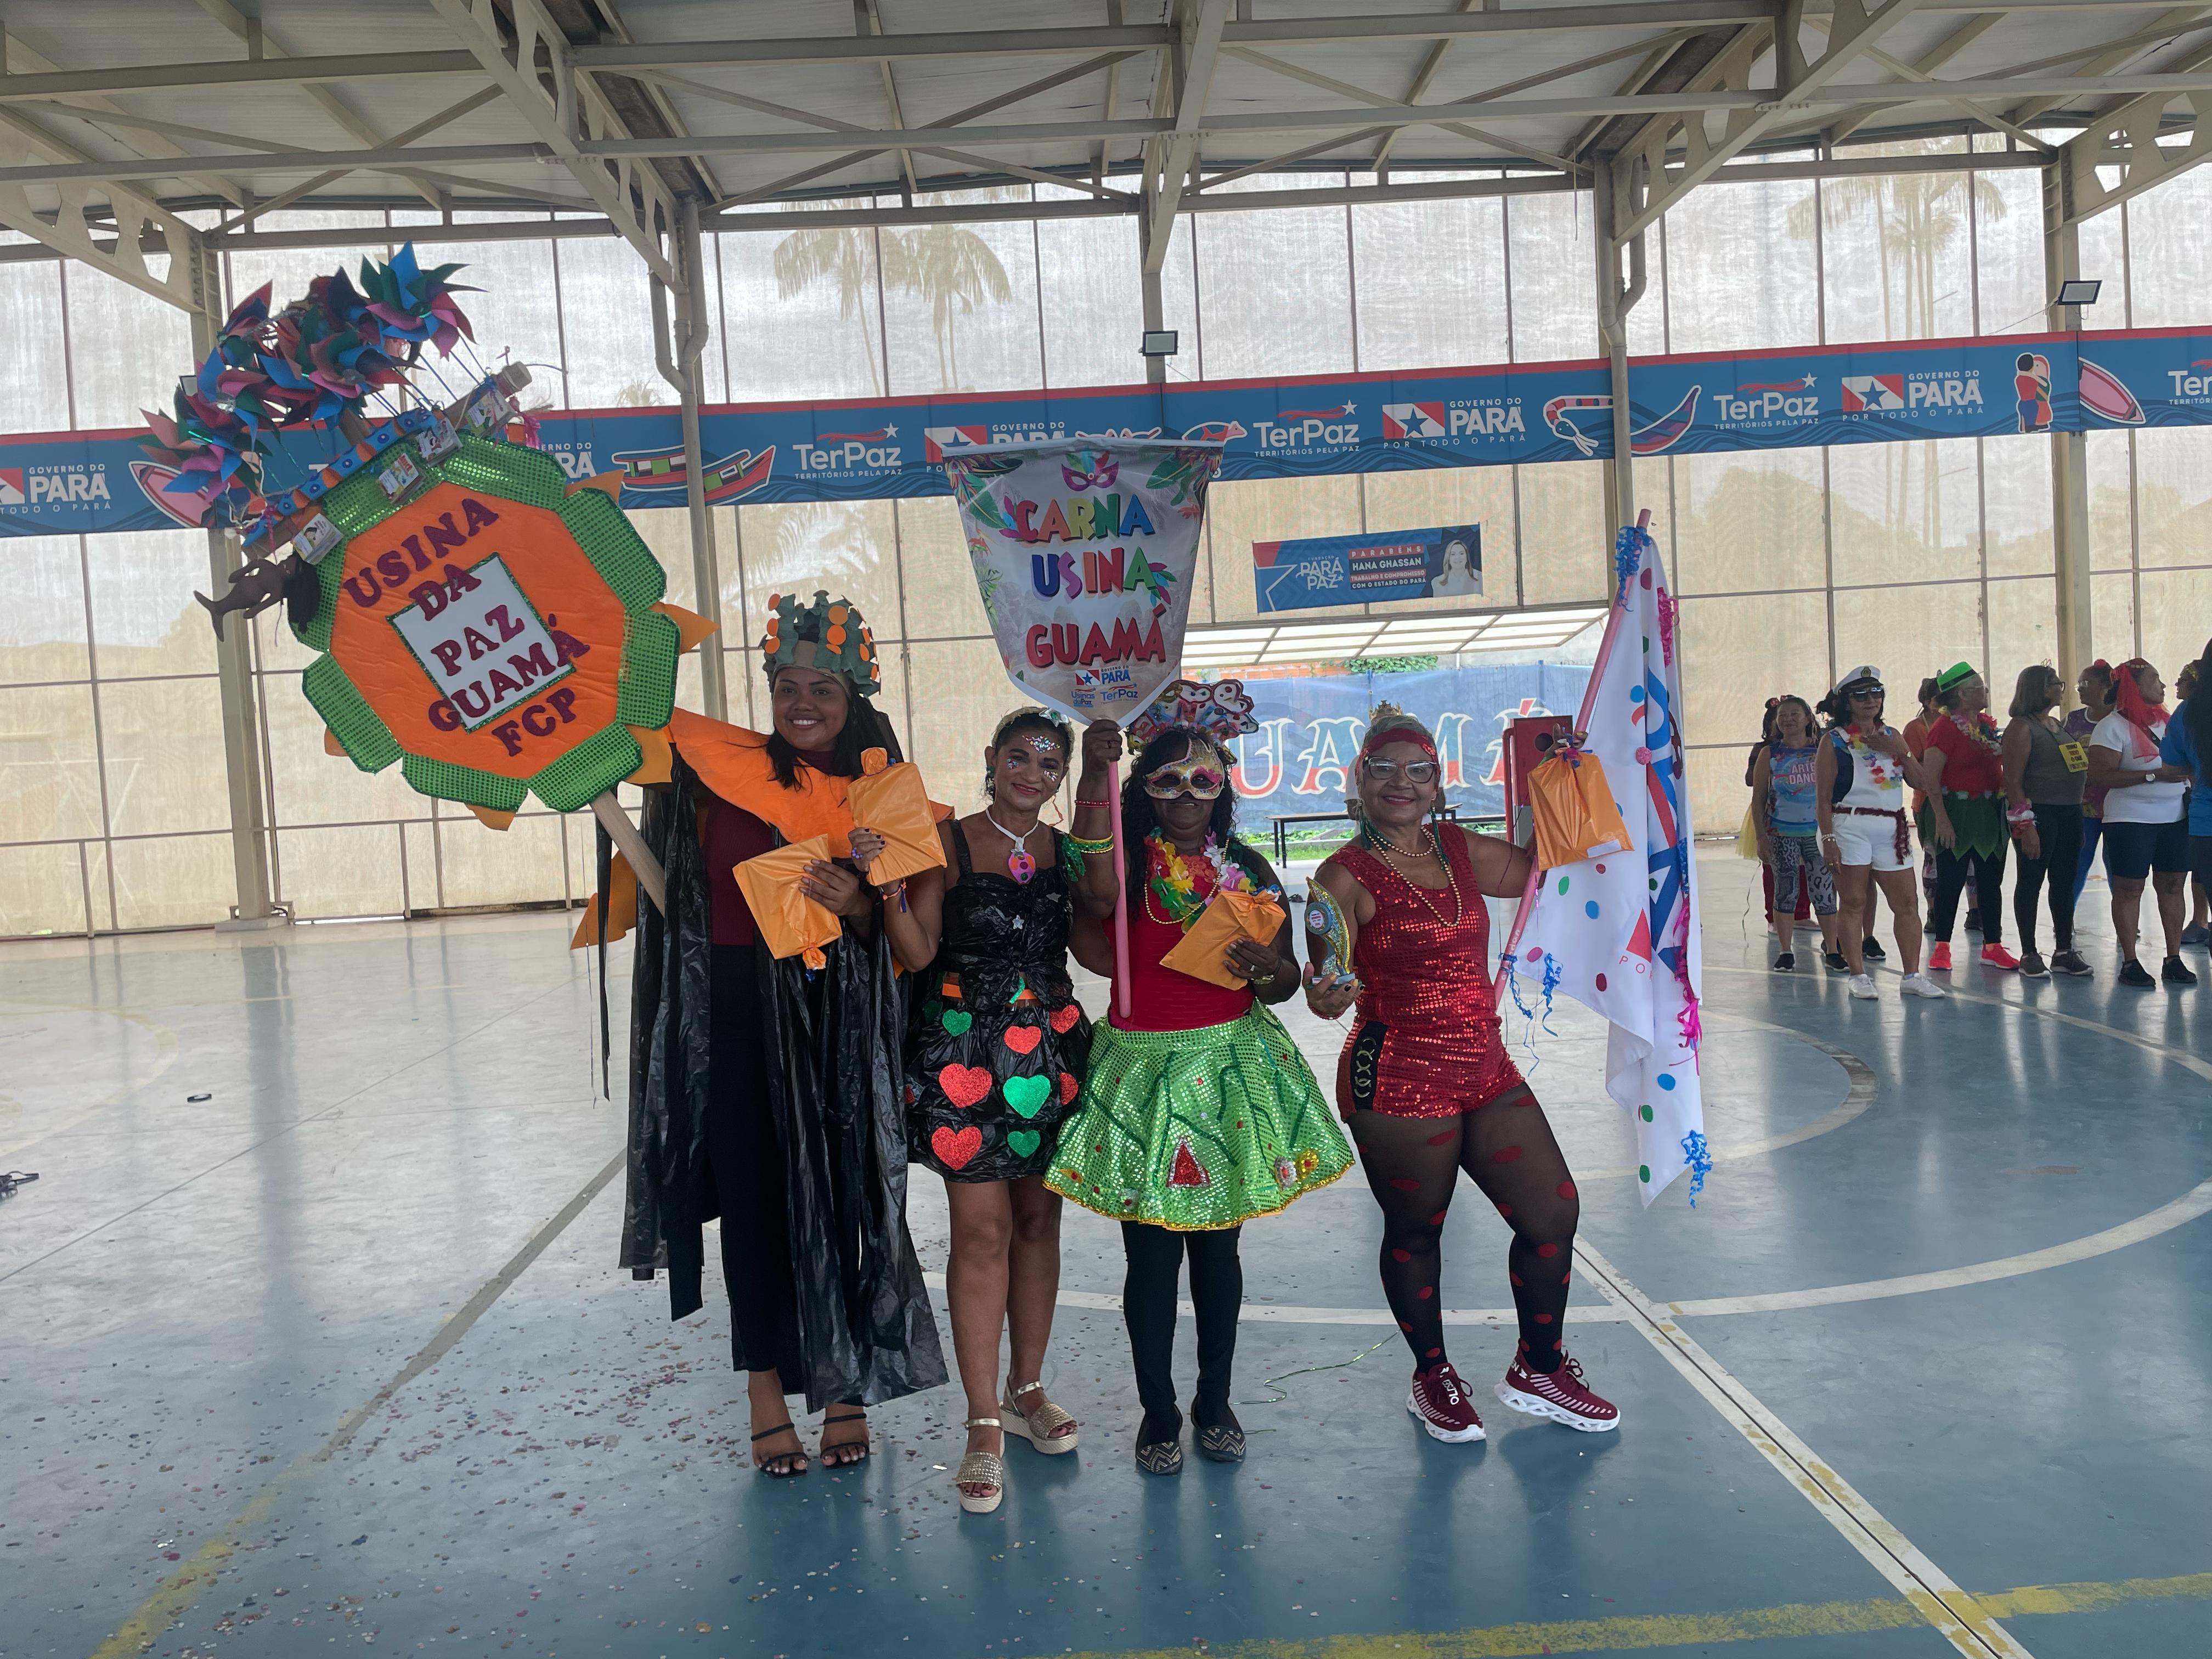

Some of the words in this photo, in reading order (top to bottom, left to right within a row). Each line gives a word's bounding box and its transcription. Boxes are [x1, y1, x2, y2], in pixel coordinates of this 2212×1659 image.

[1909, 371, 1960, 380] GOVERNO
[1909, 379, 1984, 409] PARÁ
[2169, 397, 2212, 405] TERRITÓR
[1449, 398, 1502, 408] GOVERNO
[1713, 392, 1819, 421] TerPaz
[1449, 407, 1526, 436] PARÁ
[1842, 414, 1869, 422] POR
[1880, 411, 1918, 419] TODO
[1948, 406, 1983, 415] PARÁ
[992, 422, 1045, 431] GOVERNO
[1253, 419, 1359, 448] TerPaz
[1714, 421, 1773, 430] TERRITÓRIOS
[541, 443, 571, 452] ERNO
[1383, 441, 1410, 449] POR
[1421, 438, 1460, 447] TODO
[1489, 434, 1525, 443] PARÁ
[792, 442, 902, 470] TerPaz
[1255, 448, 1313, 457] TERRITÓRIOS
[29, 465, 84, 475] GOVERNO
[555, 452, 597, 478] RÁ
[795, 471, 854, 479] TERRITÓRIOS
[29, 472, 111, 504] PARÁ
[0, 505, 41, 515] TODO
[53, 504, 60, 512] O
[72, 501, 111, 511] PARÁ
[1017, 493, 1155, 543] CARNA
[343, 498, 499, 608] USINA
[1352, 545, 1421, 557] PARABÉNS
[1300, 557, 1344, 577] PARÁ
[1352, 561, 1378, 571] HANA
[1379, 557, 1421, 568] GHASSAN
[1031, 546, 1156, 599] USINA
[1384, 570, 1425, 579] COMPROMISSO
[1307, 573, 1338, 590] PAZ
[409, 564, 482, 621] DA
[431, 605, 525, 677] PAZ
[1026, 603, 1166, 668] GUAMÁ
[428, 613, 590, 731] GUAMÁ
[1071, 691, 1095, 699] Usinas
[1100, 689, 1138, 701] TerPaz
[492, 688, 575, 757] FCP
